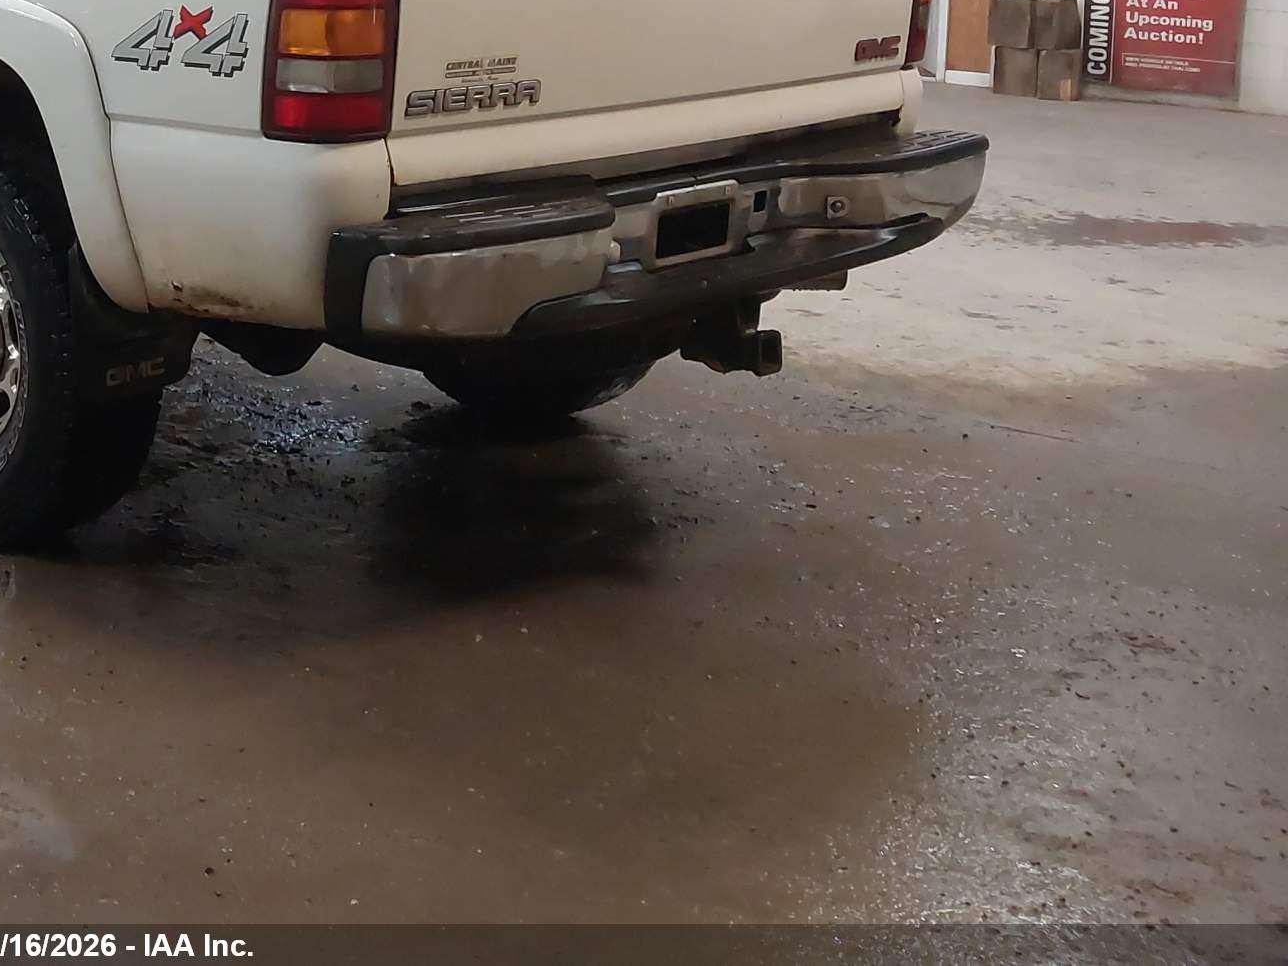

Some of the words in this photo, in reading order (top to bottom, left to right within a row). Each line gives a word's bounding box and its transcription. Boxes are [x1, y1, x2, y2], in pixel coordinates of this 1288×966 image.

[1125, 10, 1214, 32] Upcoming
[854, 35, 902, 62] GMC
[1123, 27, 1204, 45] Auction!
[404, 79, 542, 118] SIERRA
[106, 356, 166, 387] GMC
